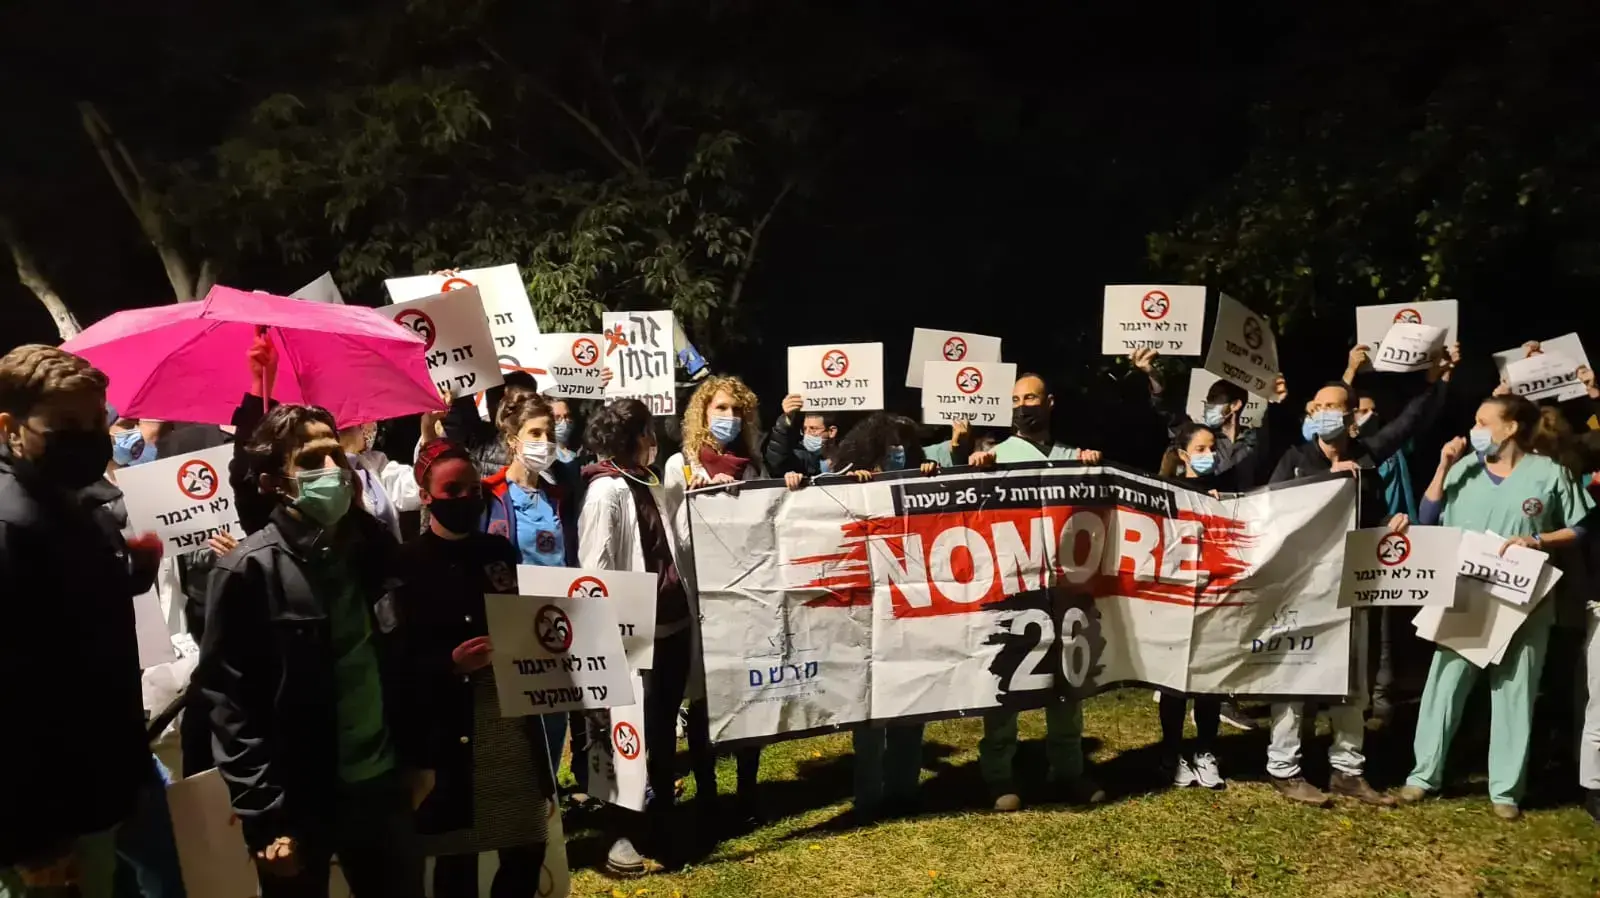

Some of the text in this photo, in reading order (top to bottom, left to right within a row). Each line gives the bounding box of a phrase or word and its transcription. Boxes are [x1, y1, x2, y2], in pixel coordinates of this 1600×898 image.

[494, 312, 514, 325] זה
[1120, 321, 1188, 332] זה לא ייגמר
[629, 316, 661, 348] זה
[495, 335, 516, 348] עד
[1168, 341, 1183, 350] עד
[425, 345, 474, 369] זה לא
[553, 366, 600, 378] לא ייגמר
[619, 347, 668, 388] הזמן
[455, 372, 476, 388] עד
[802, 378, 869, 390] זה לא ייגמר
[1518, 371, 1577, 394] שביתה
[806, 396, 866, 408] עד שתקצר
[936, 395, 1000, 406] זה לא ייגמר
[982, 412, 996, 422] עד
[181, 467, 214, 493] 26
[955, 487, 978, 504] 26
[994, 486, 1006, 502] ל
[1069, 482, 1095, 498] ולא
[903, 491, 950, 509] שעות
[156, 497, 229, 526] לא ייגמר
[1381, 540, 1405, 558] 26
[1353, 566, 1435, 580] זה לא ייגמר
[1461, 560, 1531, 588] שביתה
[1354, 589, 1429, 603] עד שתקצר
[1009, 607, 1090, 690] 26
[1252, 636, 1314, 654] מרשם
[513, 655, 606, 675] זה לא ייגמר
[749, 661, 818, 687] מרשם
[523, 686, 608, 708] עד שתקצר
